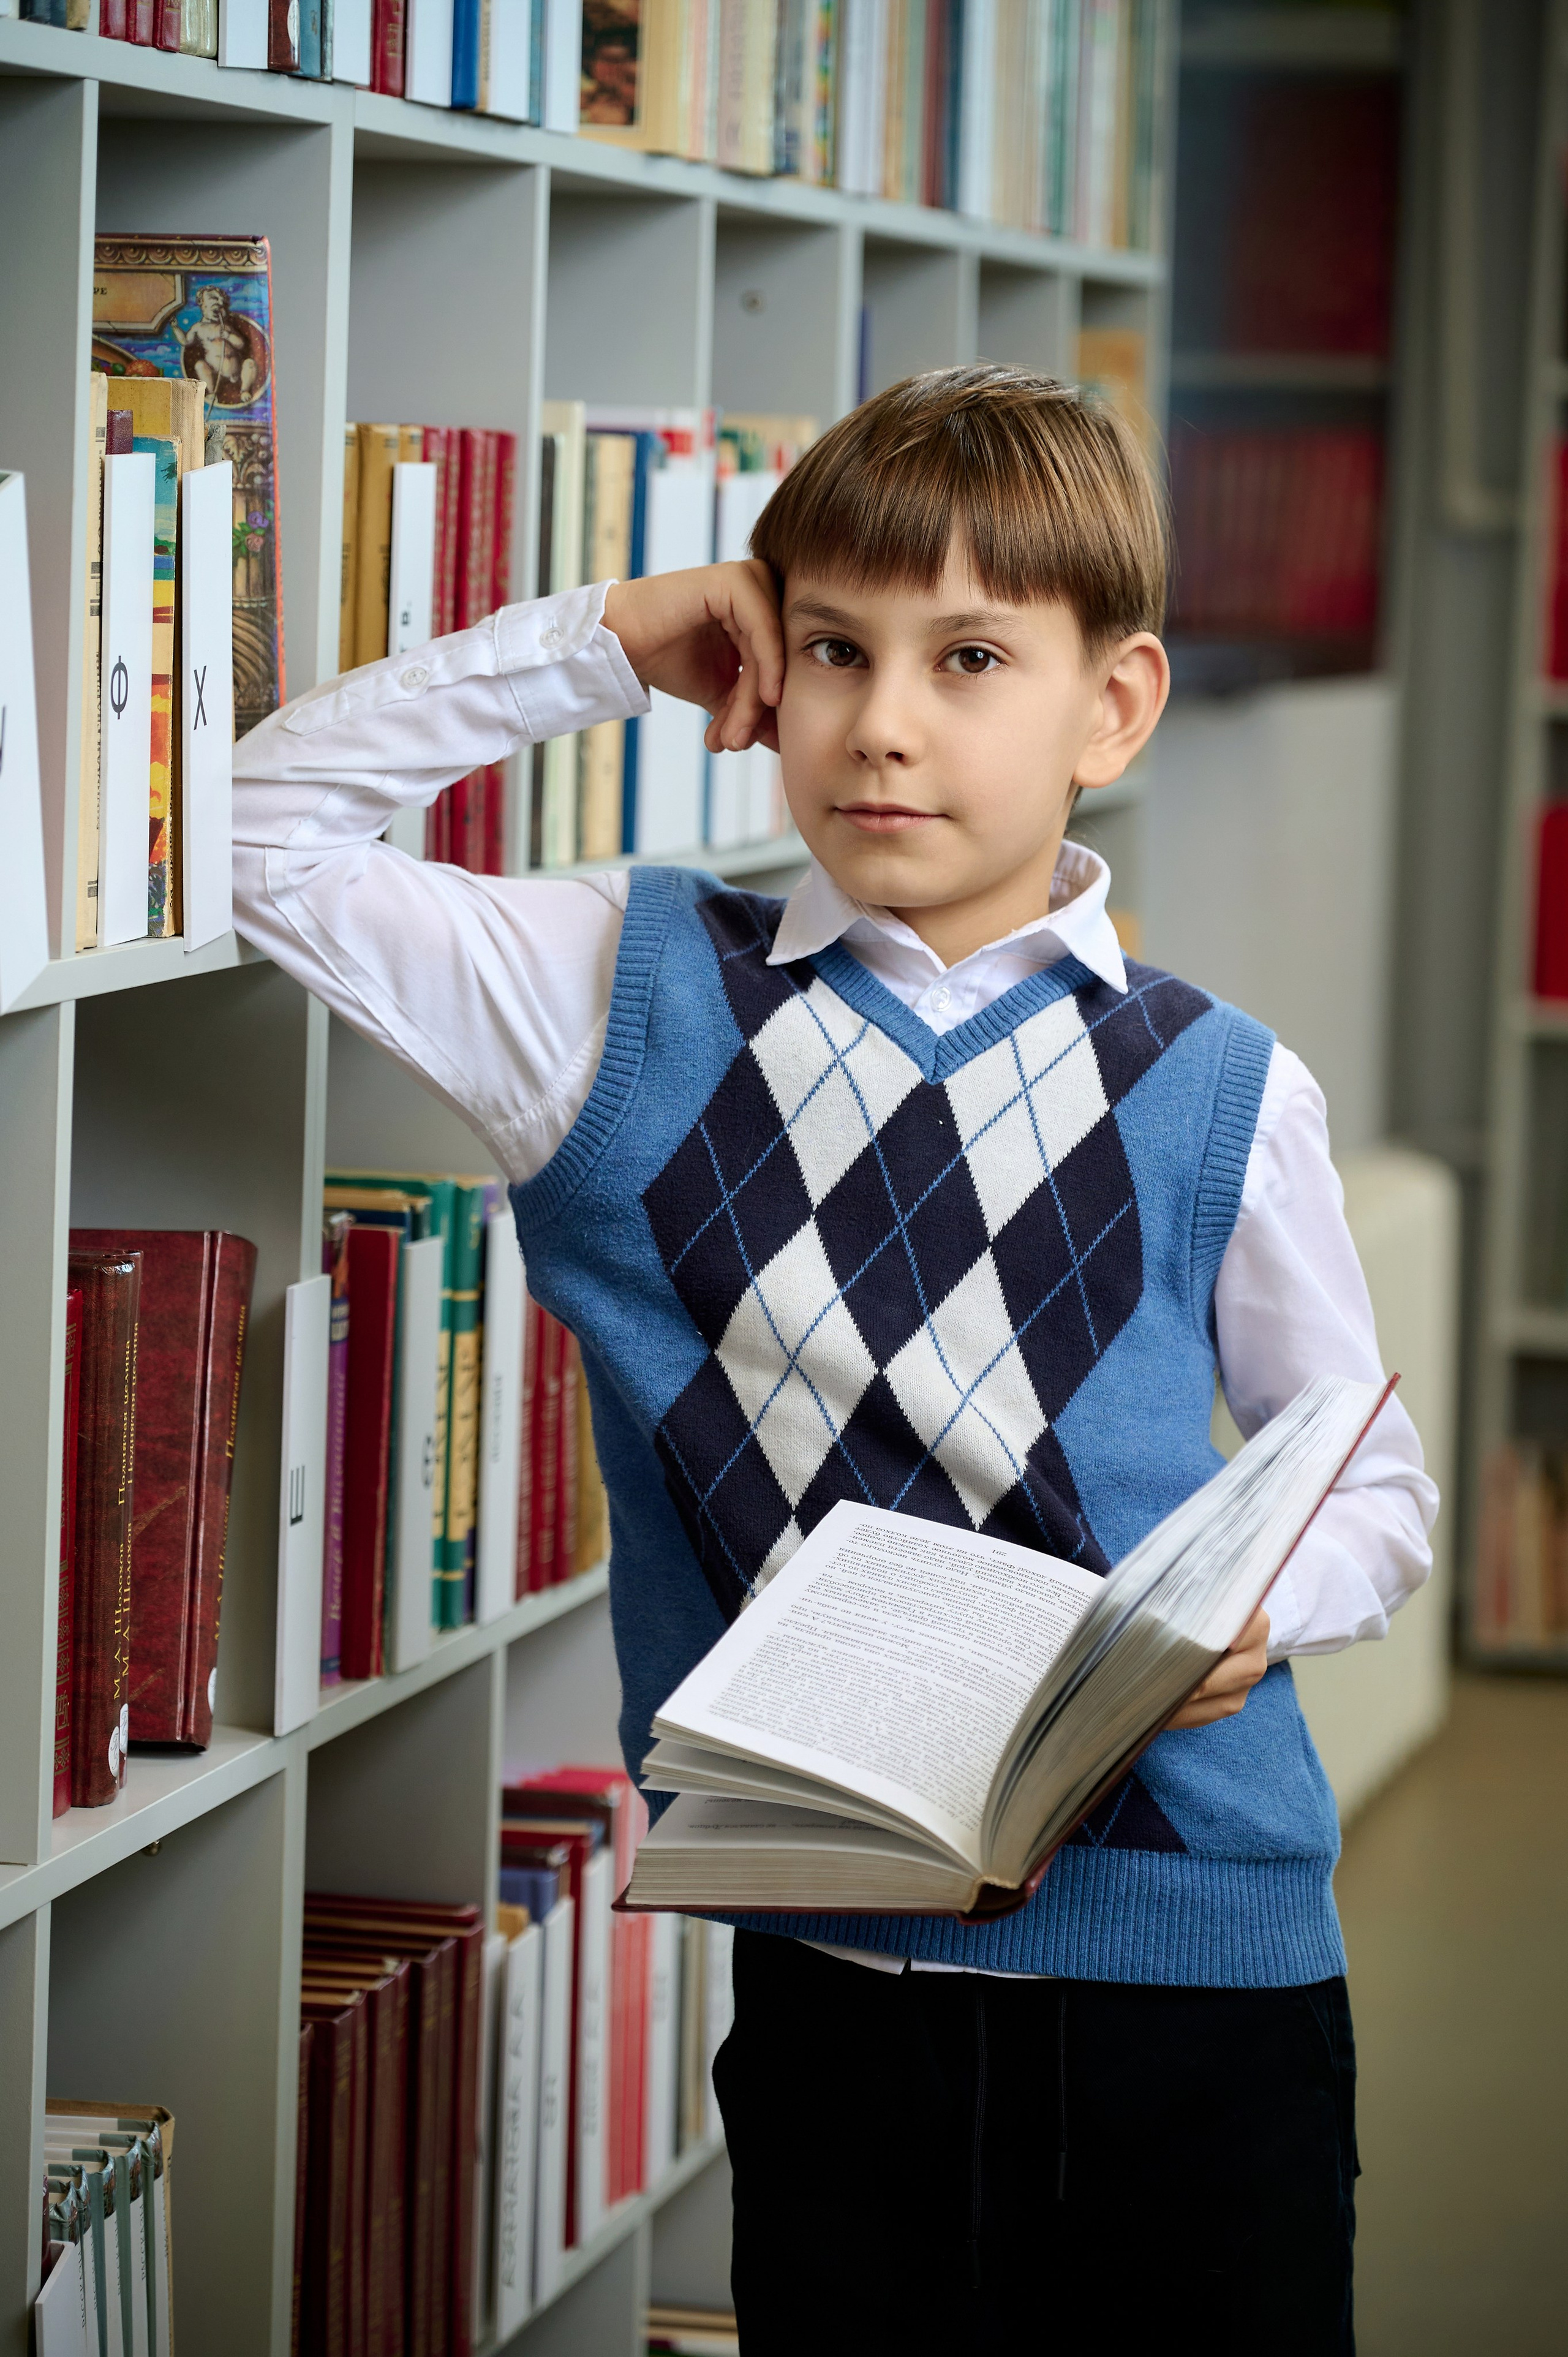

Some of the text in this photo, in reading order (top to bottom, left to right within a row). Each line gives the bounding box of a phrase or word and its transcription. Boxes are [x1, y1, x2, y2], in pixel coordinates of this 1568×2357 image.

[111, 655, 129, 720] Ф
[194, 665, 207, 731] Х
[127, 1393, 136, 1484] Поднятая
[118, 1411, 128, 1506] Поднятая
[290, 1463, 305, 1526] Ш
[852, 1530, 886, 1542] скорее.
[854, 1526, 881, 1536] будет
[875, 1527, 907, 1537] колхоз
[848, 1534, 885, 1547] племен-
[881, 1534, 929, 1549] хозяйство
[886, 1540, 918, 1551] можно
[909, 1536, 931, 1544] деле
[932, 1542, 954, 1551] этом
[839, 1547, 887, 1563] огорчения
[860, 1543, 908, 1558] несколько
[887, 1545, 922, 1557] завести
[930, 1547, 974, 1561] молочное
[832, 1555, 888, 1574] появивших-
[910, 1556, 943, 1568] купить
[923, 1555, 946, 1563] надо
[937, 1553, 974, 1566] сделать
[947, 1561, 973, 1572] удой,
[987, 1558, 1016, 1569] Факт,
[123, 1522, 132, 1613] Шолохов
[837, 1567, 858, 1576] ней,
[861, 1569, 894, 1580] планах
[864, 1559, 927, 1579] достижениях
[918, 1569, 947, 1580] конец
[944, 1566, 968, 1576] Надо
[973, 1563, 1028, 1584] необходимо
[976, 1559, 1049, 1586] постановленное
[1017, 1566, 1047, 1580] доход!
[895, 1578, 922, 1588] своих
[898, 1574, 939, 1588] сообщил
[971, 1573, 1013, 1590] уймищу.
[974, 1569, 1014, 1585] высокий
[115, 1543, 124, 1635] Шолохов
[812, 1580, 843, 1591] молоч-
[815, 1575, 876, 1597] приспособля-
[847, 1580, 886, 1593] котором
[867, 1575, 940, 1599] прислушивался
[927, 1577, 987, 1597] технических
[940, 1585, 979, 1599] попутно
[968, 1583, 1022, 1604] продукции,
[1014, 1586, 1036, 1597] надо
[1017, 1582, 1055, 1599] дающих
[1045, 1588, 1061, 1597] Все
[844, 1589, 869, 1599] Логу
[895, 1593, 945, 1610] интересов,
[930, 1588, 976, 1604] рассказал
[1038, 1596, 1056, 1606] нам
[870, 1596, 916, 1613] Гремячем
[878, 1593, 963, 1622] бесхитростностью
[941, 1596, 999, 1617] недоверчиво
[941, 1602, 970, 1613] жить.
[981, 1597, 1017, 1613] фермы,
[988, 1595, 1035, 1615] новейших
[946, 1608, 974, 1620] кругу
[977, 1601, 1031, 1625] разговором,
[1024, 1602, 1069, 1625] молочной
[123, 1620, 130, 1641] А.
[926, 1613, 1013, 1647] организовавшейся
[964, 1620, 1004, 1637] наивной
[976, 1617, 999, 1629] тому
[986, 1615, 1022, 1632] должен
[1000, 1615, 1036, 1633] вначале
[1017, 1611, 1062, 1634] молочной
[1009, 1630, 1057, 1656] Давыдову,
[1012, 1638, 1031, 1650] Она
[1047, 1642, 1060, 1651] ей
[114, 1641, 121, 1664] А.
[122, 1649, 129, 1677] М.
[114, 1670, 121, 1700] М.
